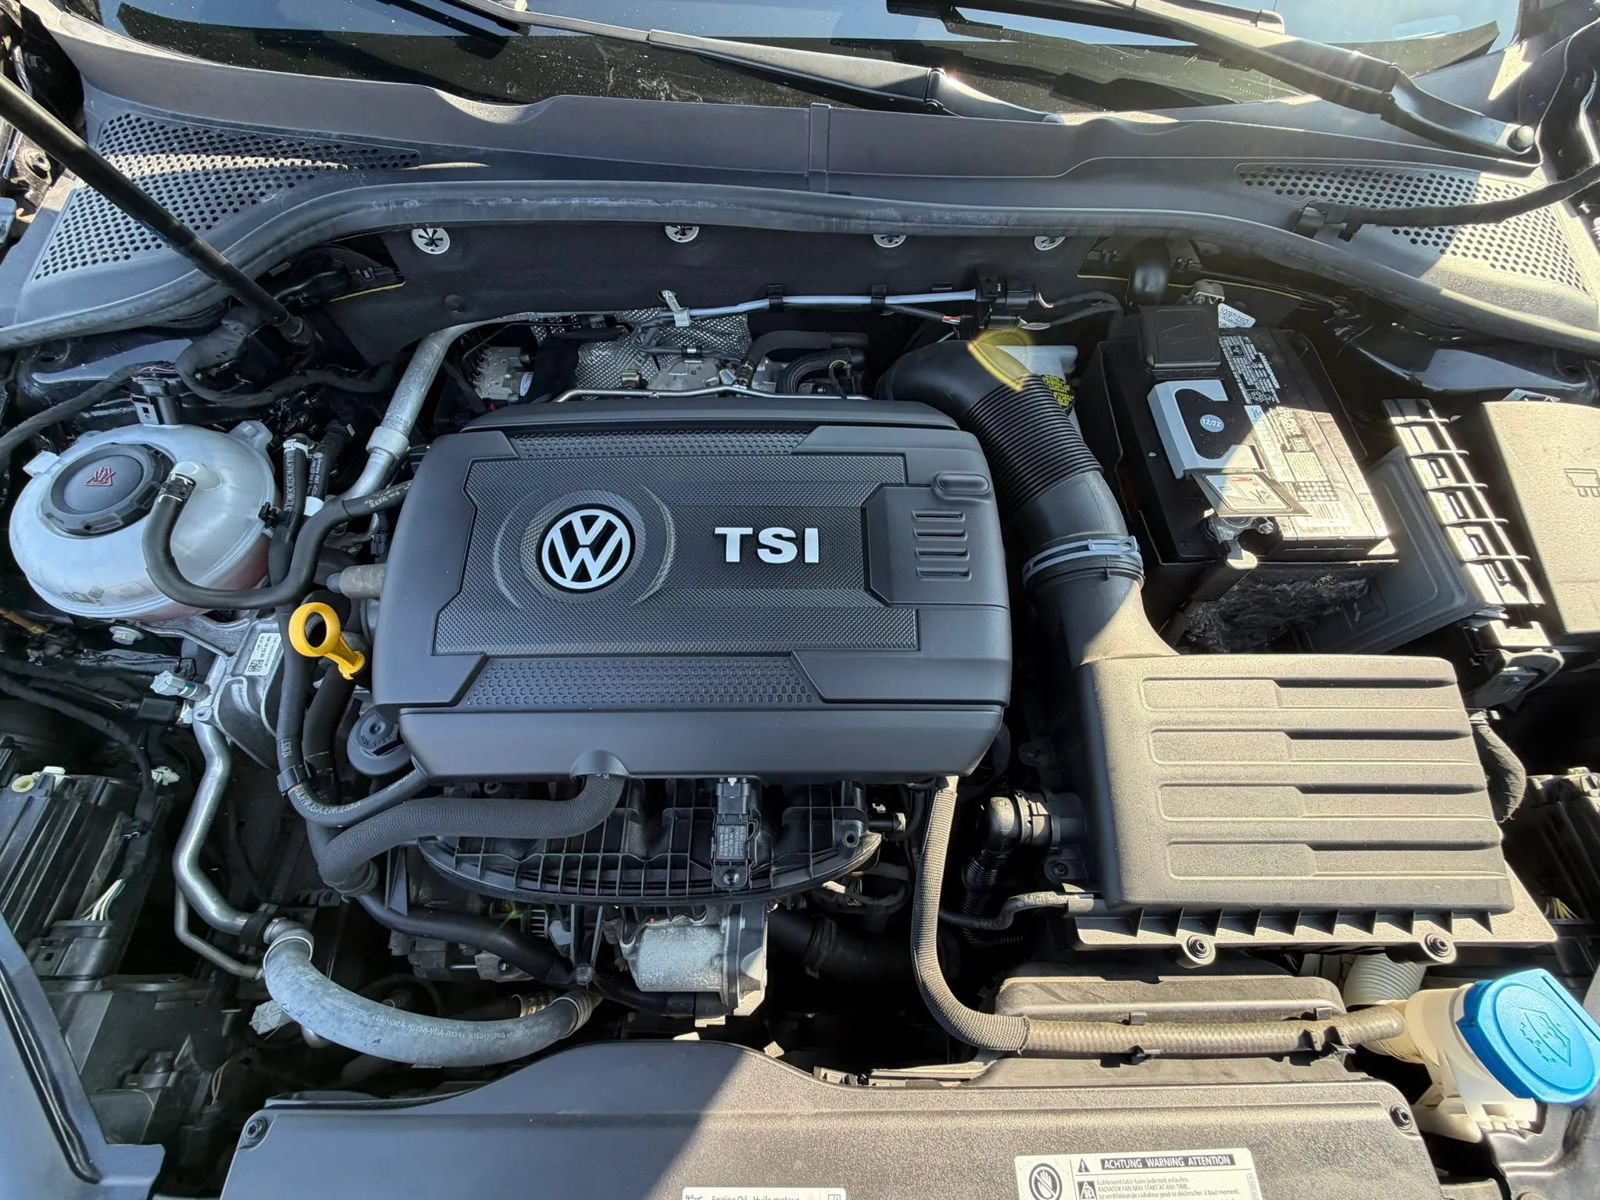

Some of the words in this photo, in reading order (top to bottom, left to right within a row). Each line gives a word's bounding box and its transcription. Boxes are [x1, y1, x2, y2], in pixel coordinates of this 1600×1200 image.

[714, 527, 819, 564] TSI
[1103, 1160, 1143, 1170] ACHTUNG
[1146, 1157, 1183, 1168] WARNING
[1188, 1155, 1231, 1167] ATTENTION
